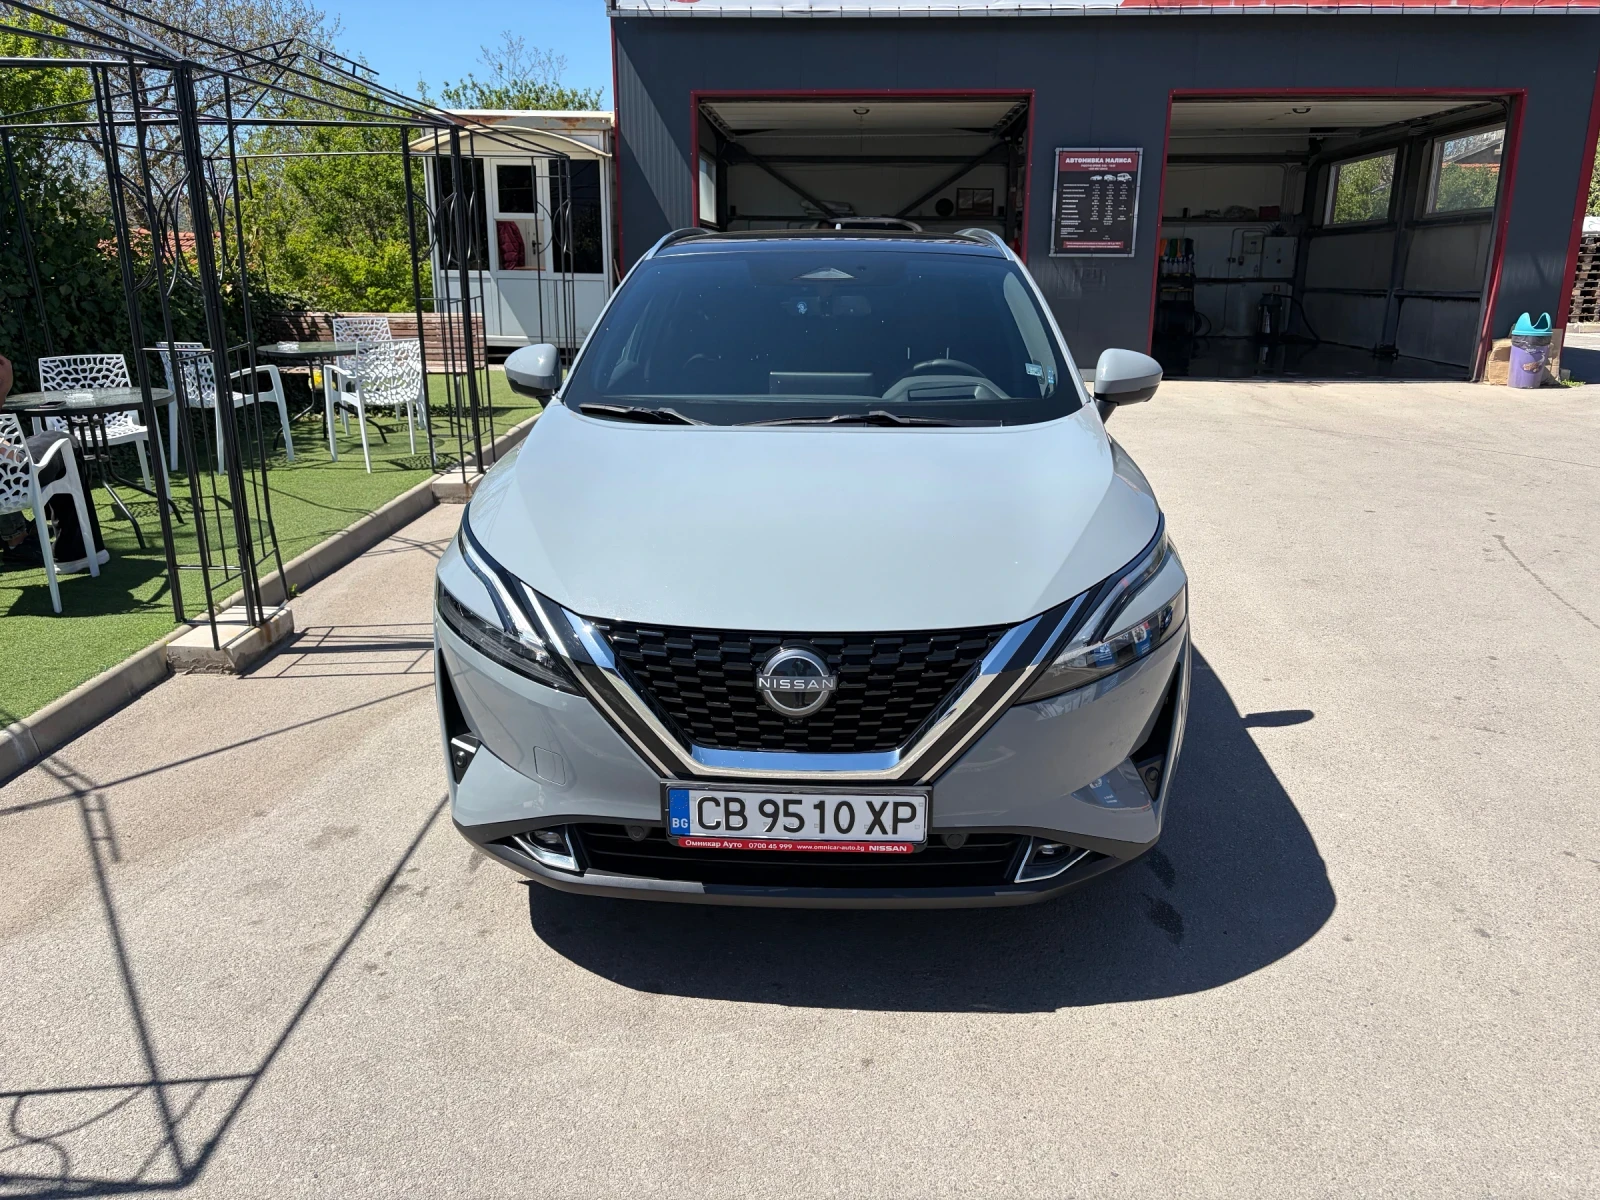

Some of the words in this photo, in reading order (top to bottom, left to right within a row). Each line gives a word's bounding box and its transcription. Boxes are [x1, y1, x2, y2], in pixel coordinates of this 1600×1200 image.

[758, 677, 834, 689] NISSAN
[758, 798, 856, 834] 9510
[672, 817, 688, 829] BG
[685, 839, 721, 848] Омникар
